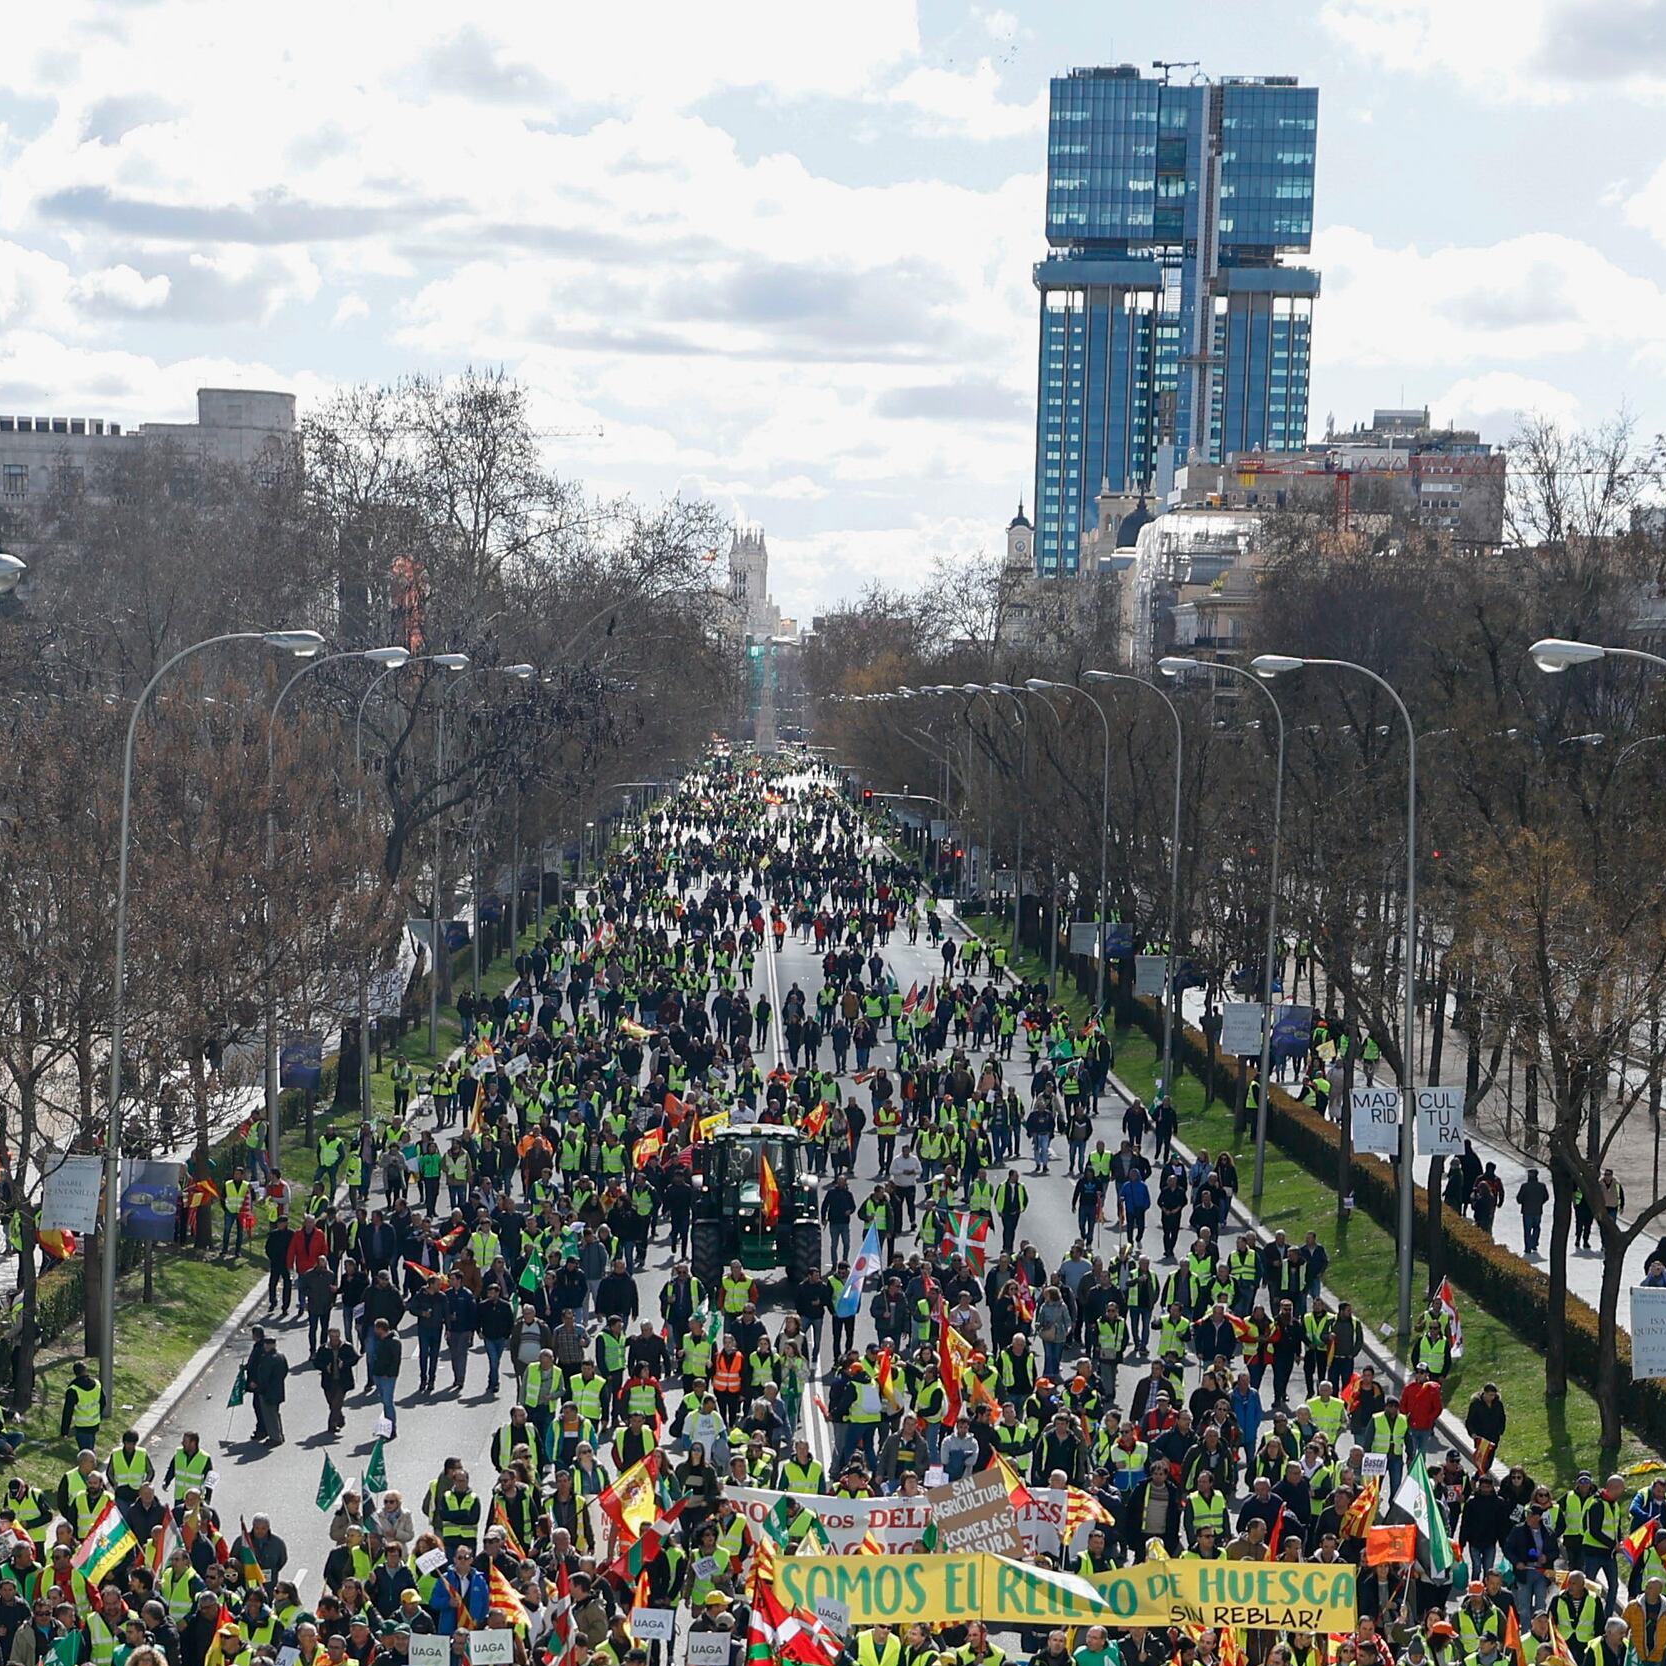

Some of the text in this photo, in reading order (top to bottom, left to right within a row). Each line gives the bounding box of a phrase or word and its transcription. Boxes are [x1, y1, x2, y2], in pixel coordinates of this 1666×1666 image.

[1353, 1092, 1398, 1108] MAD
[1419, 1092, 1456, 1109] CUL
[1371, 1108, 1397, 1124] RID
[1424, 1110, 1450, 1126] TU
[1439, 1127, 1462, 1143] RA
[1364, 1457, 1387, 1469] Basta!
[952, 1479, 975, 1495] SIN
[933, 1484, 1009, 1521] AGRICULTURA
[783, 1562, 926, 1616] SOMOS
[945, 1562, 982, 1614] EL
[1147, 1573, 1183, 1600] DE
[1199, 1567, 1355, 1609] HUESCA
[633, 1618, 665, 1629] UAGA
[818, 1608, 843, 1624] UAGA
[1171, 1605, 1322, 1629] SIN REBLAR!
[412, 1646, 442, 1658] UAGA
[474, 1642, 505, 1654] UAGA
[691, 1644, 722, 1655] UAGA
